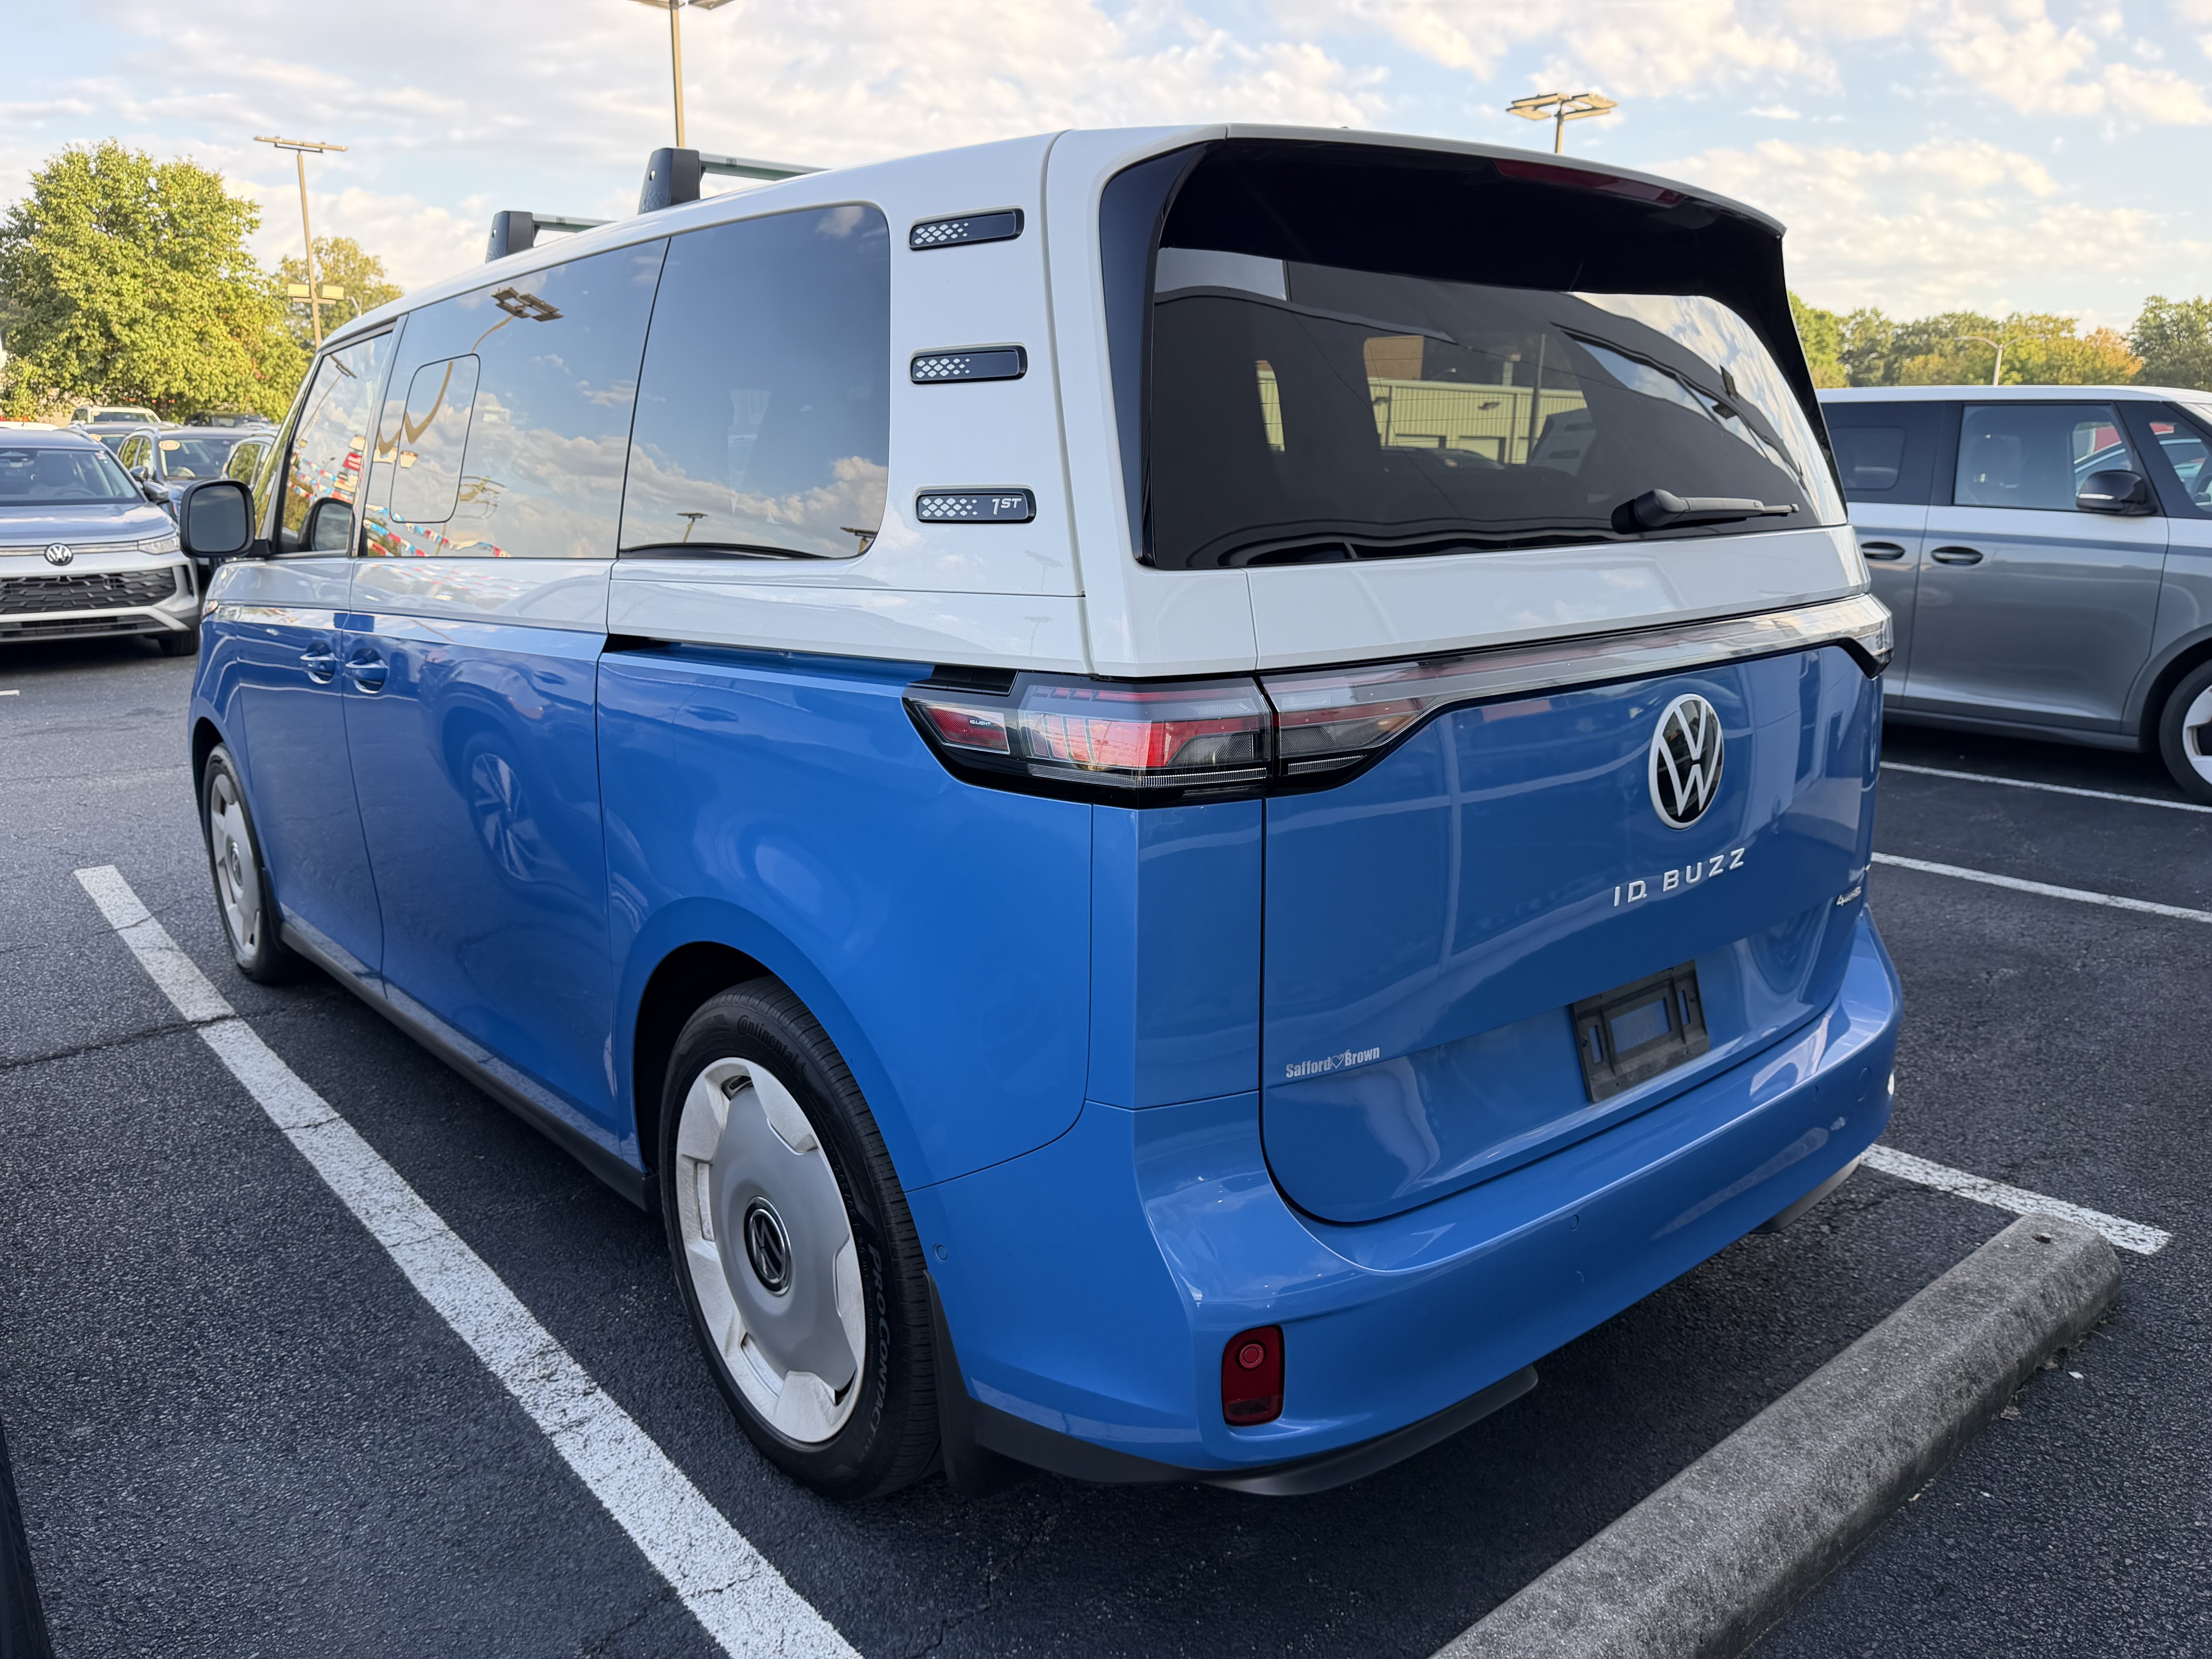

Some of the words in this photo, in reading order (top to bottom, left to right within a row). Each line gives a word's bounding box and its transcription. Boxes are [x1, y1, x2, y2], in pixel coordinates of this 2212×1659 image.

[992, 498, 1022, 515] 1ST
[1613, 880, 1647, 907] ID.
[1662, 847, 1745, 892] BUZZ
[737, 1014, 799, 1068] Continental
[1286, 1056, 1331, 1078] Safford
[1345, 1047, 1380, 1067] Brown
